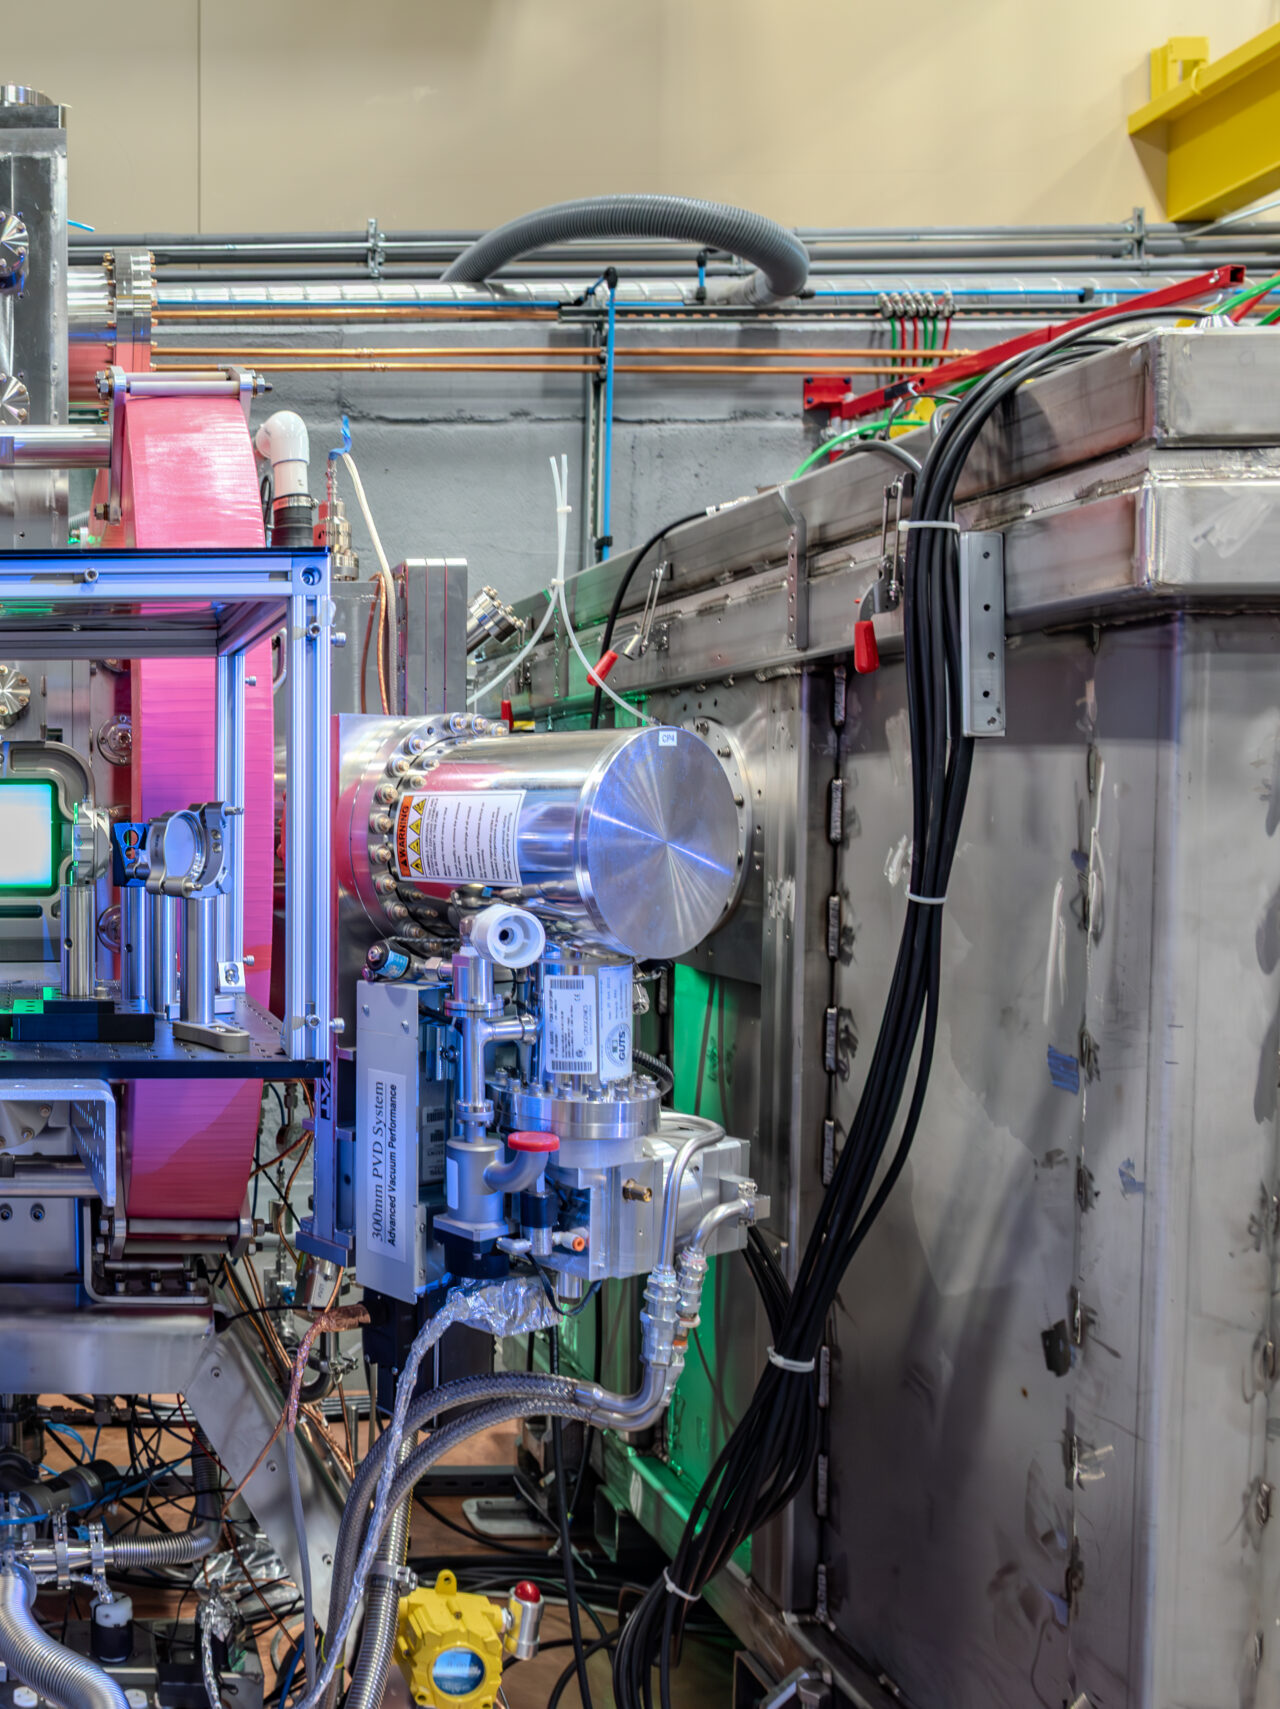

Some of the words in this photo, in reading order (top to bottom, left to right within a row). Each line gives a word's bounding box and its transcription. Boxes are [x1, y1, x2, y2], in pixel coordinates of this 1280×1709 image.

[398, 806, 409, 858] WARNING
[618, 1031, 626, 1061] GUTS
[372, 1081, 386, 1138] System
[388, 1084, 397, 1150] Performance
[371, 1141, 383, 1179] PVD
[387, 1151, 397, 1192] Vacuum
[371, 1184, 383, 1242] 300mm
[387, 1195, 397, 1247] Advanced
